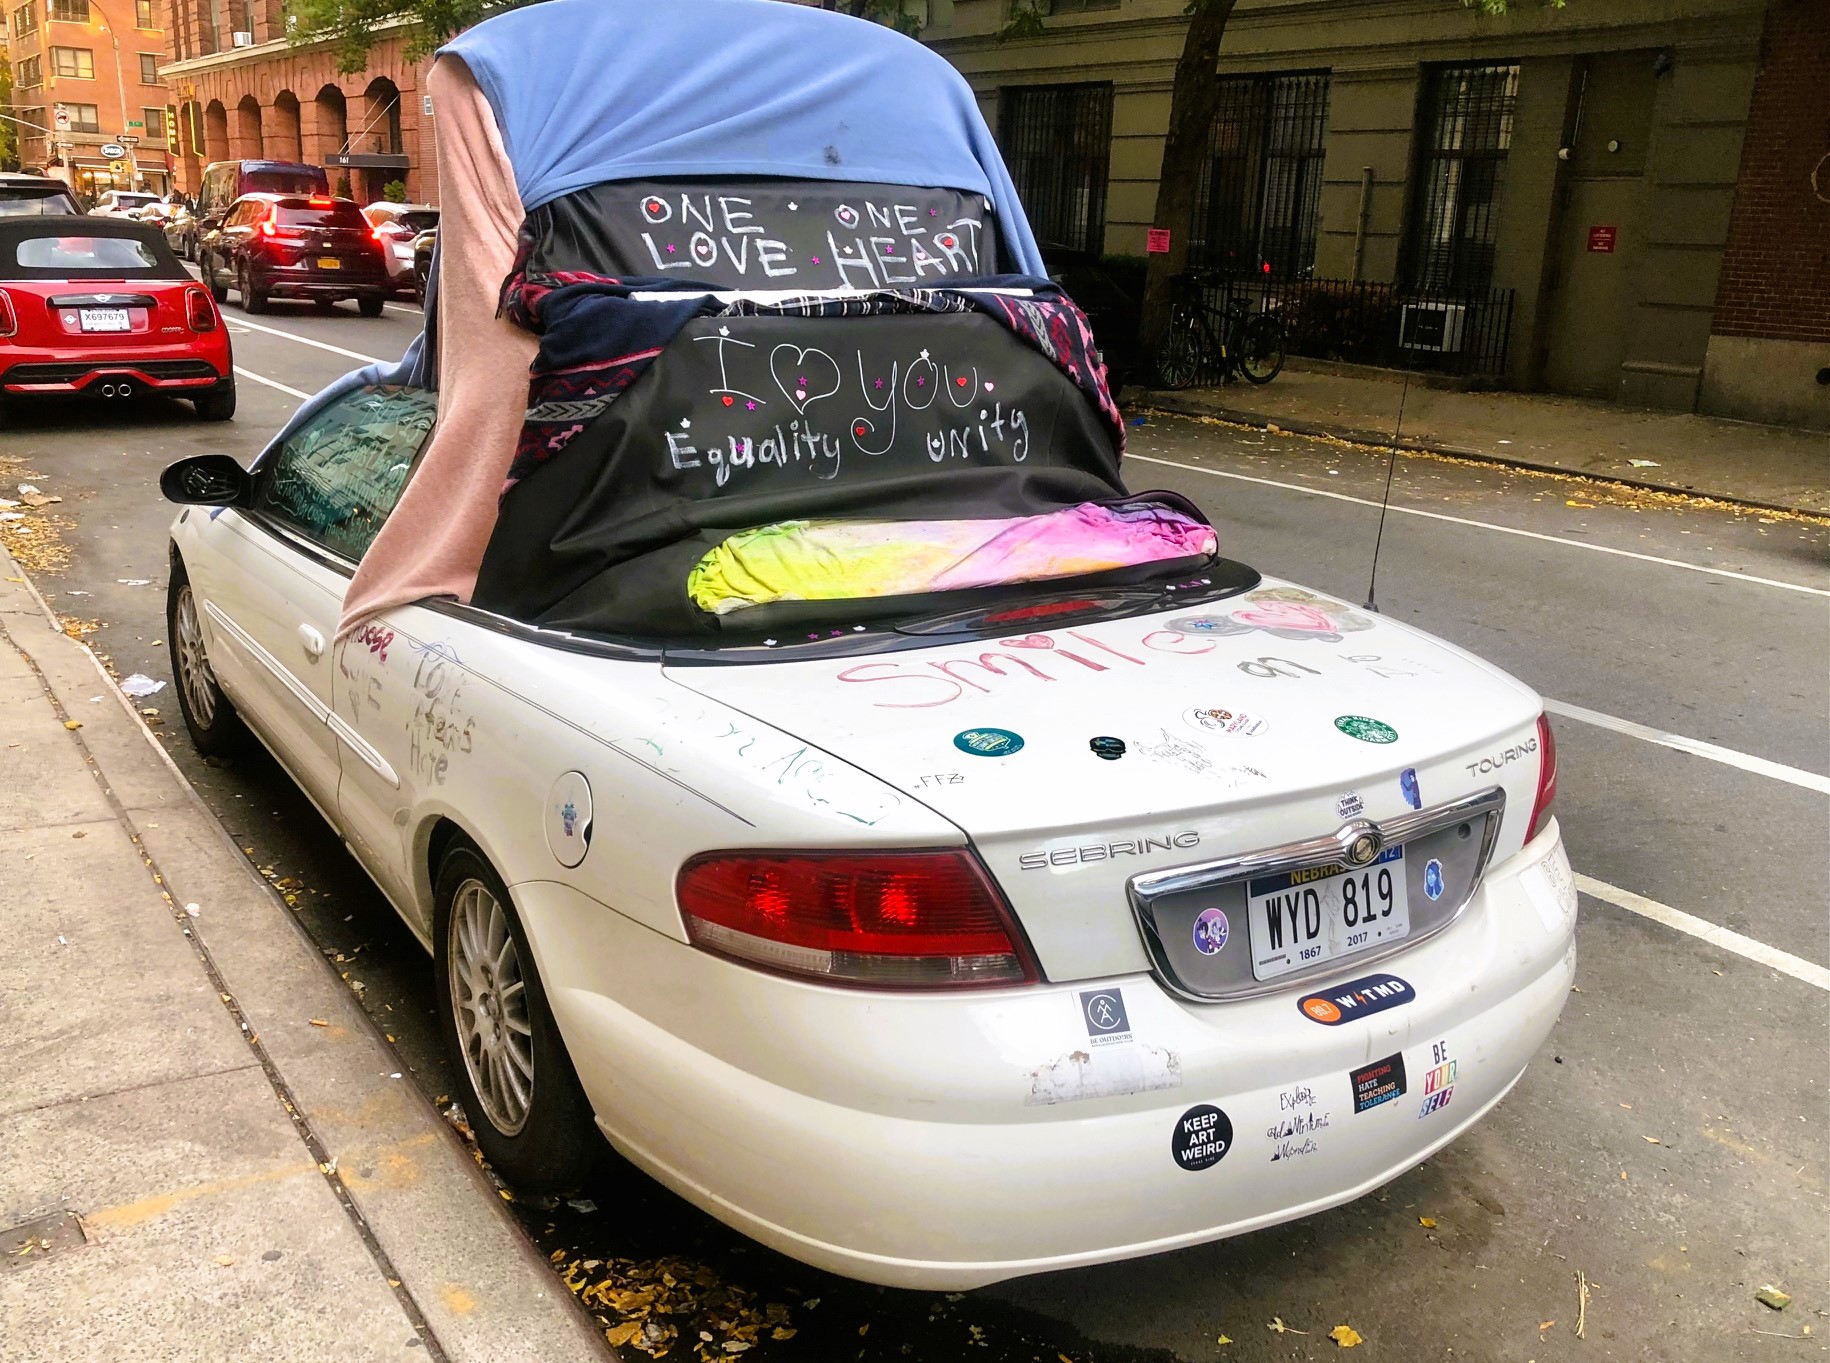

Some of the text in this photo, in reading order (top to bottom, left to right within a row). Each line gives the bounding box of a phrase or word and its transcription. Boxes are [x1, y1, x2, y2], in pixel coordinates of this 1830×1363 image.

[339, 156, 349, 164] 161
[640, 193, 765, 234] ONE
[834, 200, 927, 235] ONE
[640, 231, 798, 278] LOVE
[826, 217, 983, 291] HEART
[84, 313, 125, 321] X697679
[692, 335, 767, 405] I
[664, 420, 841, 487] Equality
[1465, 737, 1538, 778] TOURING
[1339, 804, 1364, 816] OUTSIDE
[1340, 795, 1359, 807] THINK
[1018, 829, 1201, 871] SEBRING
[1265, 868, 1393, 950] WYD 819
[1347, 932, 1369, 947] 2017
[1299, 946, 1322, 961] 1867
[1310, 1003, 1333, 1017] 89.7
[1432, 1040, 1448, 1065] BE
[1357, 1064, 1392, 1084] FIGHTING
[1425, 1060, 1457, 1095] YOUR
[1358, 1078, 1378, 1092] HATE
[1359, 1082, 1396, 1102] TEACHING
[1360, 1088, 1401, 1110] TOLERANCE
[1419, 1086, 1454, 1118] SELF
[1183, 1113, 1218, 1133] KEEP
[1189, 1128, 1216, 1146] ART
[1181, 1140, 1225, 1161] WEIRD
